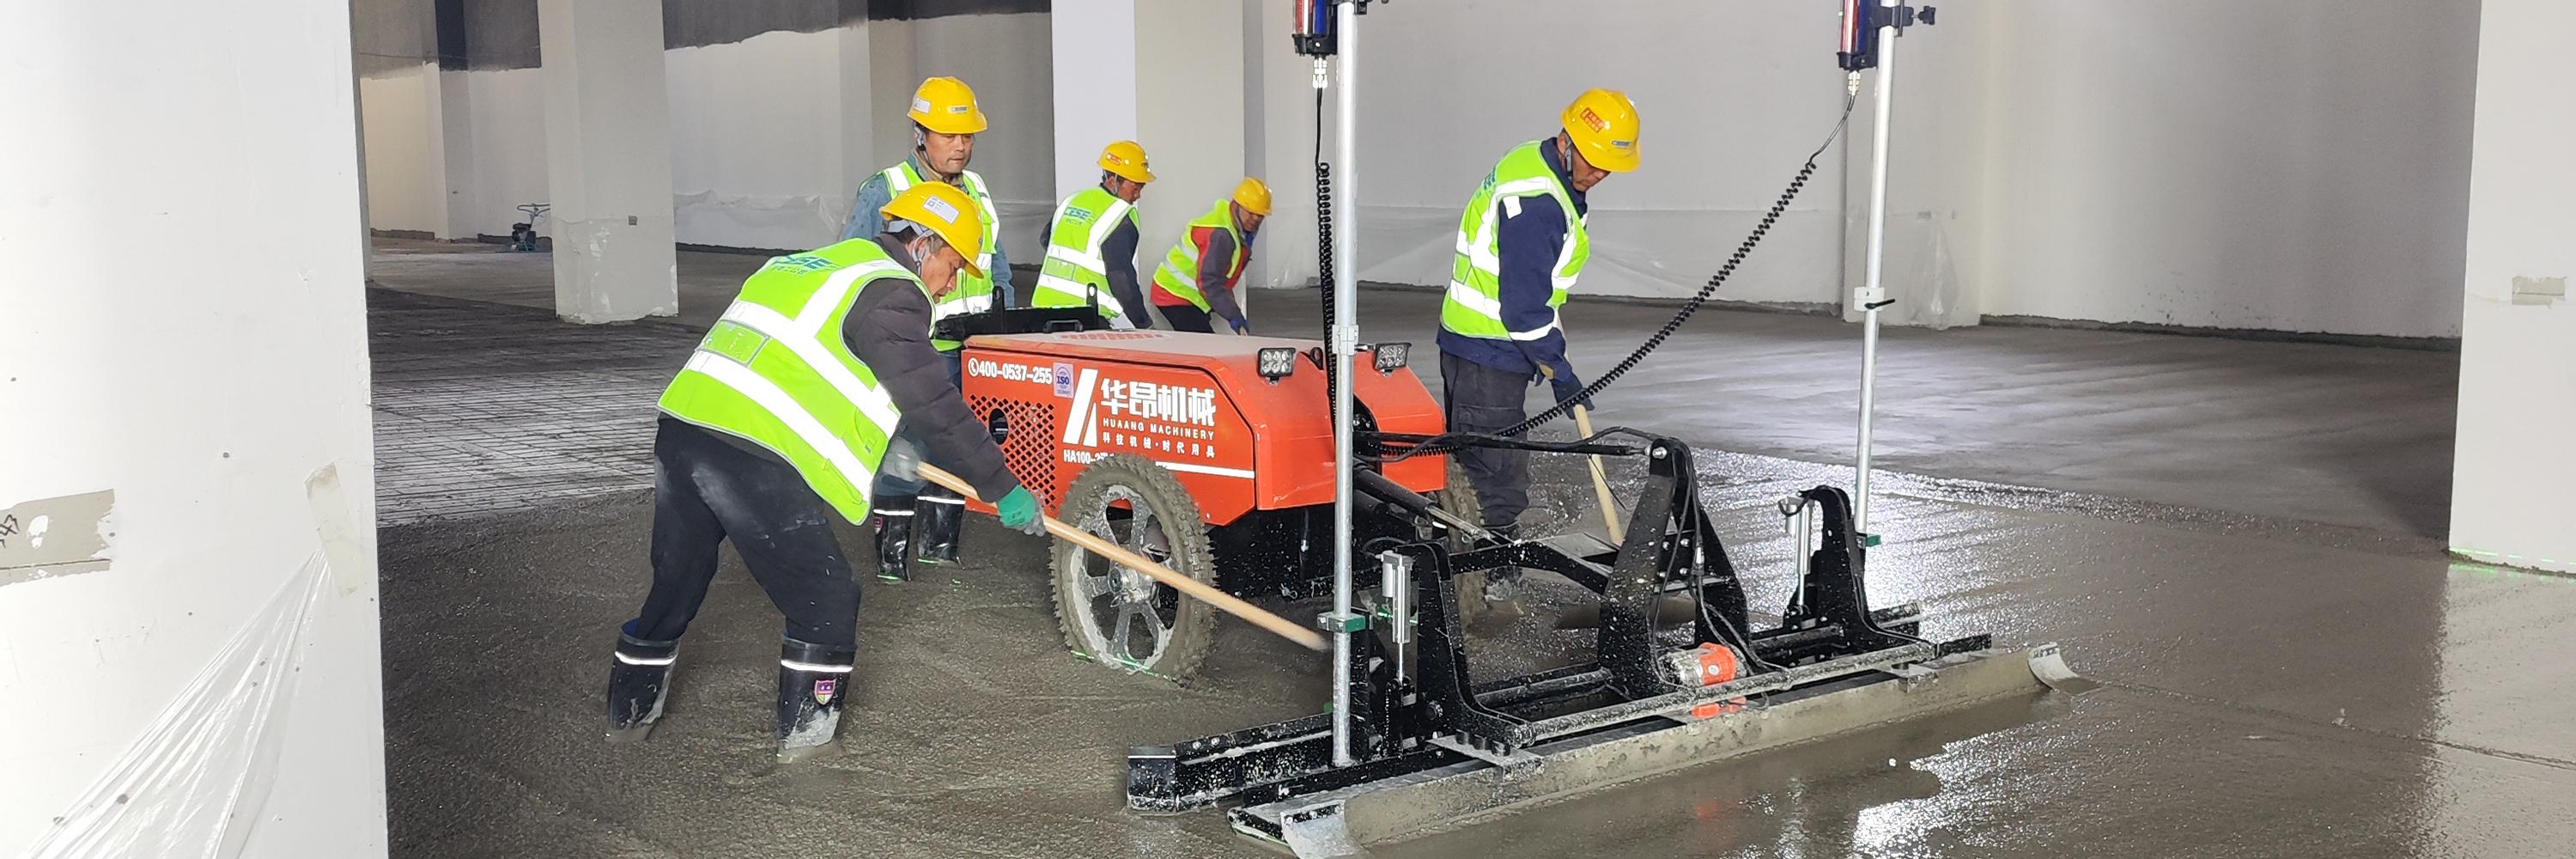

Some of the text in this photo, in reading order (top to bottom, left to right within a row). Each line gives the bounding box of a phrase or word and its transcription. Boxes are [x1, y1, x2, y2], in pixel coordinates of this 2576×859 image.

[979, 360, 1053, 385] 400-0537-255
[1056, 375, 1070, 385] ISO
[1100, 377, 1217, 427] 华昂机械
[1103, 417, 1214, 441] HUAANG MACHINERY
